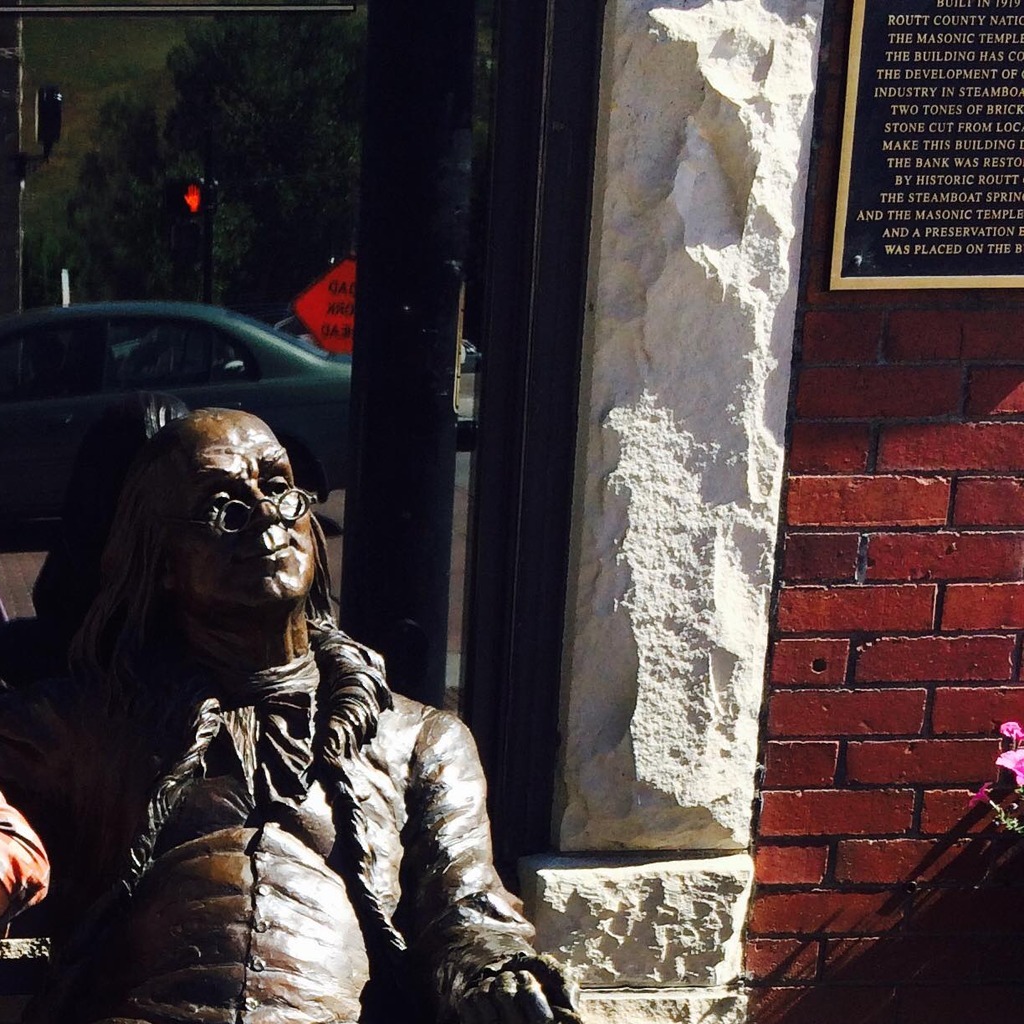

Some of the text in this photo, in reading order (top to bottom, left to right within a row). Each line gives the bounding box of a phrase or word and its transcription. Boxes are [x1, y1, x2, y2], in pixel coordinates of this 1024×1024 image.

[936, 0, 1021, 8] BUILT IN 1919
[887, 14, 931, 26] ROUTT
[933, 14, 987, 26] COUNTY
[887, 32, 1024, 44] THE MASONIC TEMPLE
[885, 50, 911, 62] THE
[913, 50, 976, 62] BUILDING
[979, 50, 1004, 62] HAS
[876, 68, 901, 80] THE
[905, 68, 999, 80] DEVELOPMENT
[1001, 68, 1019, 80] OF
[874, 86, 938, 98] INDUSTRY
[941, 86, 955, 98] IN
[890, 104, 1024, 116] TWO TONES OF BRICK
[884, 122, 925, 133] STONE
[928, 121, 955, 133] CUT
[957, 121, 993, 133] FROM
[882, 139, 919, 151] MAKE
[922, 139, 951, 151] THIS
[955, 139, 1016, 151] BUILDING
[886, 156, 1024, 169] THE BANK WAS RESTO
[894, 175, 913, 186] BY
[916, 174, 975, 186] HISTORIC
[978, 174, 1020, 185] ROUTT
[879, 191, 1024, 204] THE STEAMBOAT SPRIN
[856, 208, 1024, 222] AND THE MASONIC TEMPLE
[882, 227, 910, 238] AND
[912, 227, 921, 238] A
[924, 226, 1016, 238] PRESERVATION
[884, 243, 1024, 255] WAS PLACED ON THE B
